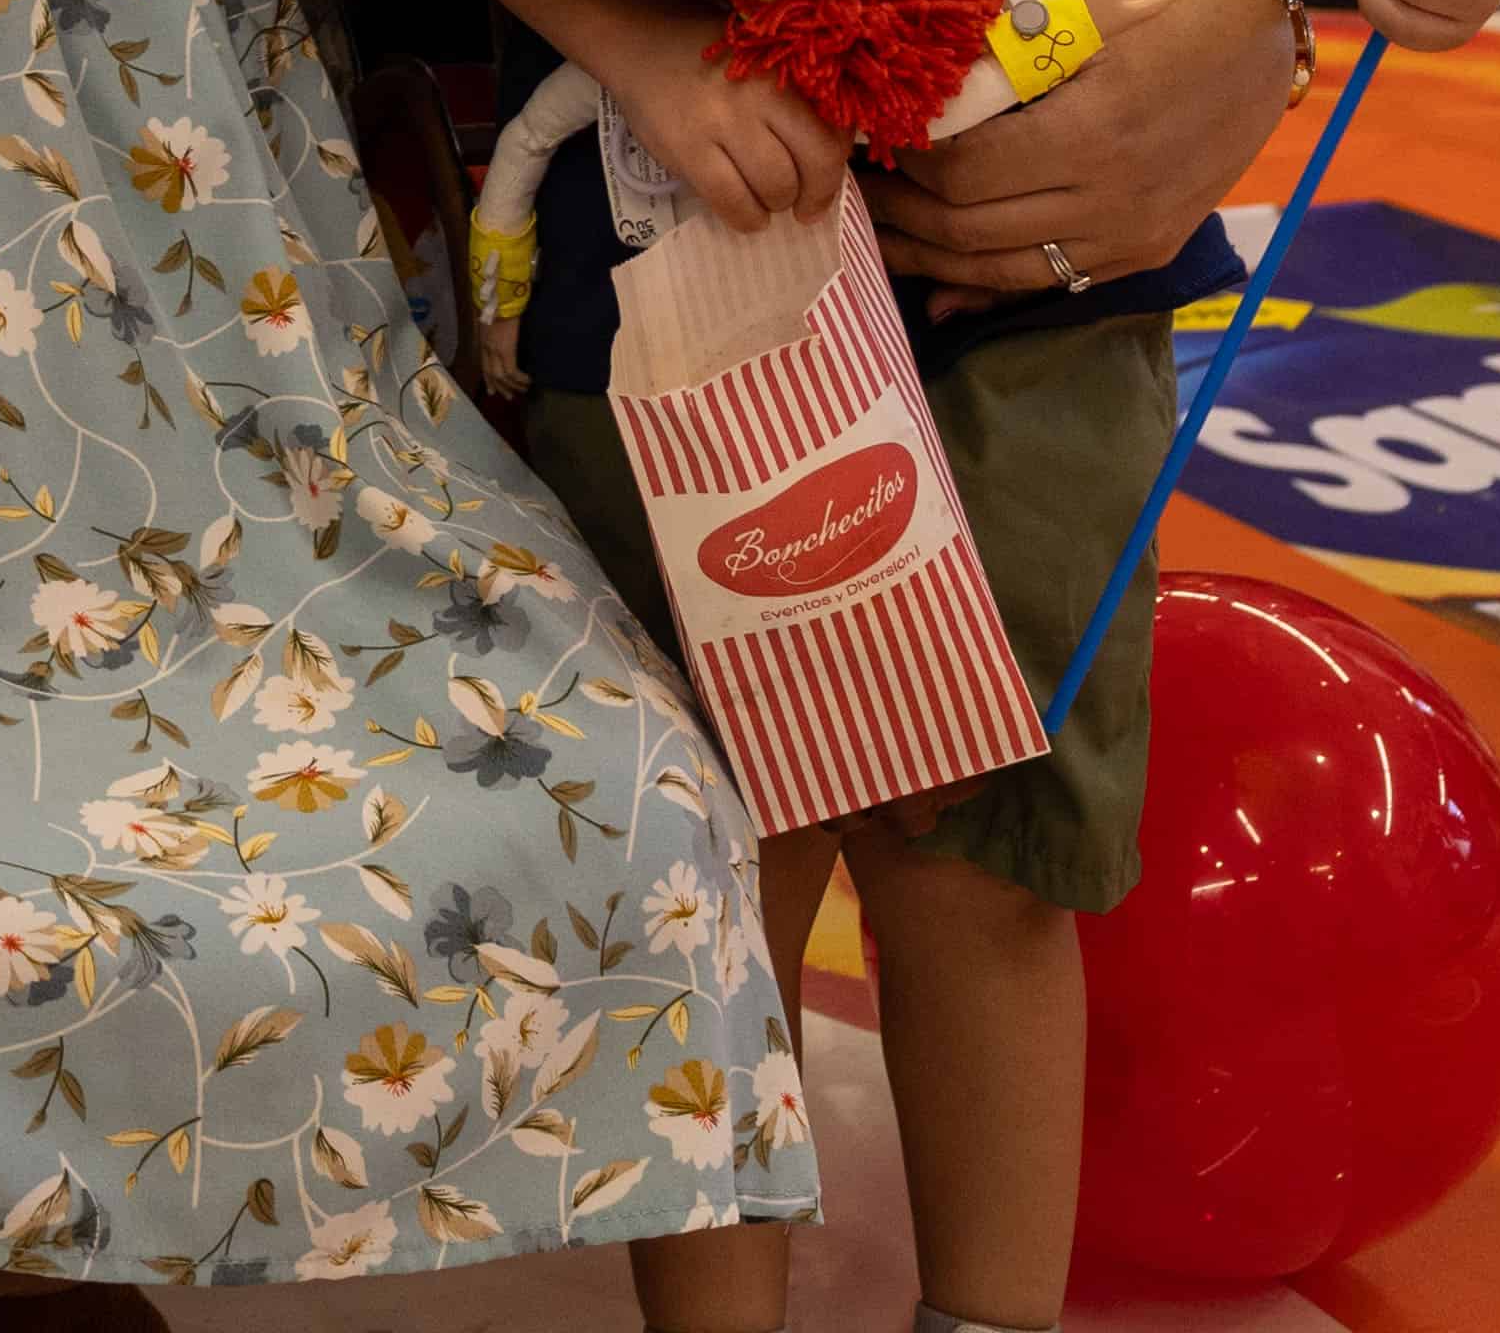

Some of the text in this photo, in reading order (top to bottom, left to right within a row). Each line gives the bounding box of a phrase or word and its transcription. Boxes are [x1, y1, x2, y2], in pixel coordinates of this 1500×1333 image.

[724, 470, 906, 578] Bonchecitos
[760, 545, 921, 621] Eventos y Diversión!
